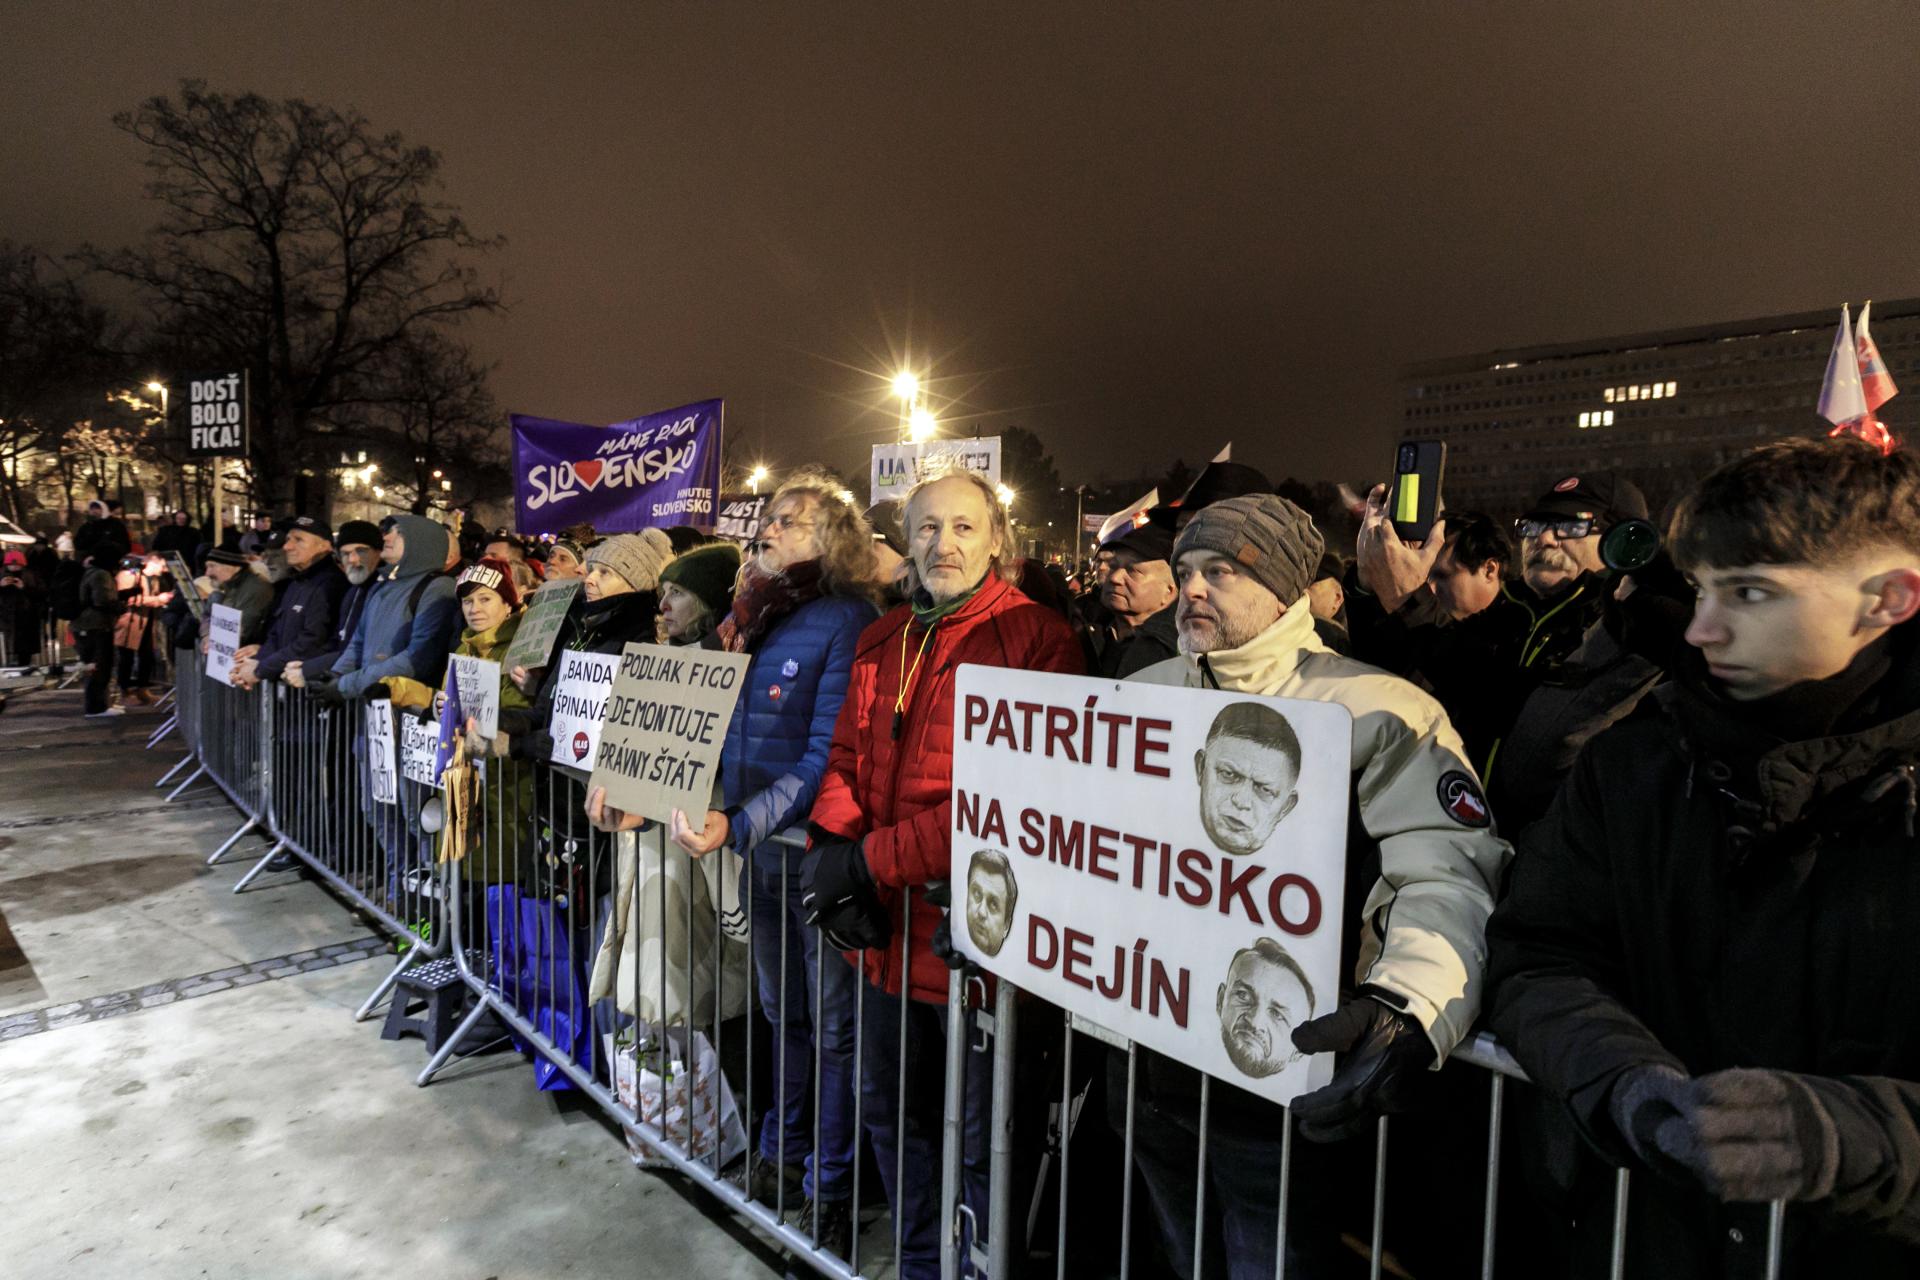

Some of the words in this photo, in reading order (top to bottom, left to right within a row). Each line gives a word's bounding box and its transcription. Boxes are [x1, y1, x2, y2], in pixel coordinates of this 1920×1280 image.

[190, 373, 240, 402] DOSŤ
[190, 402, 240, 426] BOLO
[191, 424, 240, 449] FICA!
[596, 428, 656, 455] MÁME
[526, 439, 697, 510] SLOVENSKO
[652, 498, 712, 517] SLOVENSKO
[677, 487, 712, 499] HNUTIE
[720, 496, 765, 518] DOSŤ
[621, 652, 685, 684] PODLIAK
[688, 662, 736, 690] FICO
[555, 688, 609, 722] ŠPINAVÁ
[608, 695, 720, 745] DEMONTUJE
[964, 695, 1172, 778] PATRÍTE
[598, 737, 651, 780] PRÁVNY
[648, 747, 705, 791] ŠTÁT
[956, 789, 1009, 848] NA
[1018, 808, 1322, 936] SMETISKO
[1028, 913, 1190, 1030] DEJÍN
